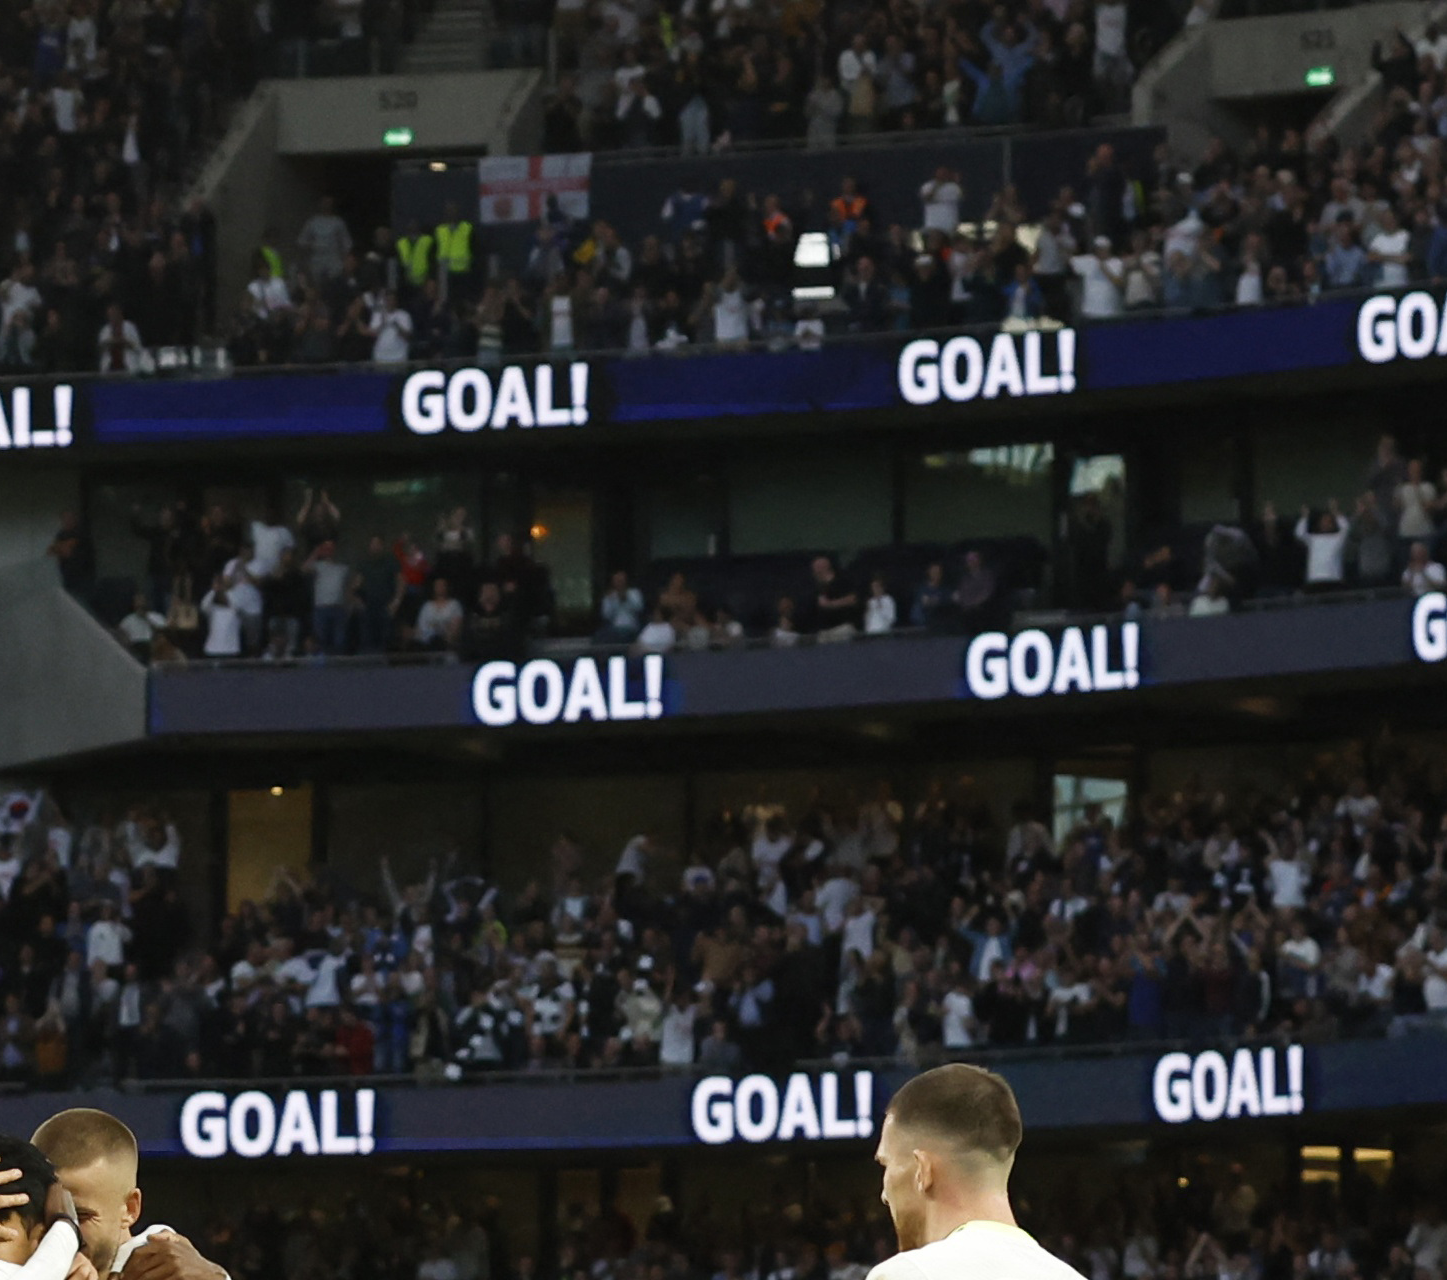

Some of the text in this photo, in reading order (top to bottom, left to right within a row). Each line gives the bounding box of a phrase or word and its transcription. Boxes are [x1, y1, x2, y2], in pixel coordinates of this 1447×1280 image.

[402, 362, 588, 433] GOAL!
[898, 327, 1076, 404] GOAL!
[473, 654, 663, 726] GOAL!
[967, 622, 1139, 698] GOAL!
[692, 1071, 873, 1143] GOAL!
[1154, 1045, 1304, 1122] GOAL!
[181, 1089, 375, 1157] GOAL!
